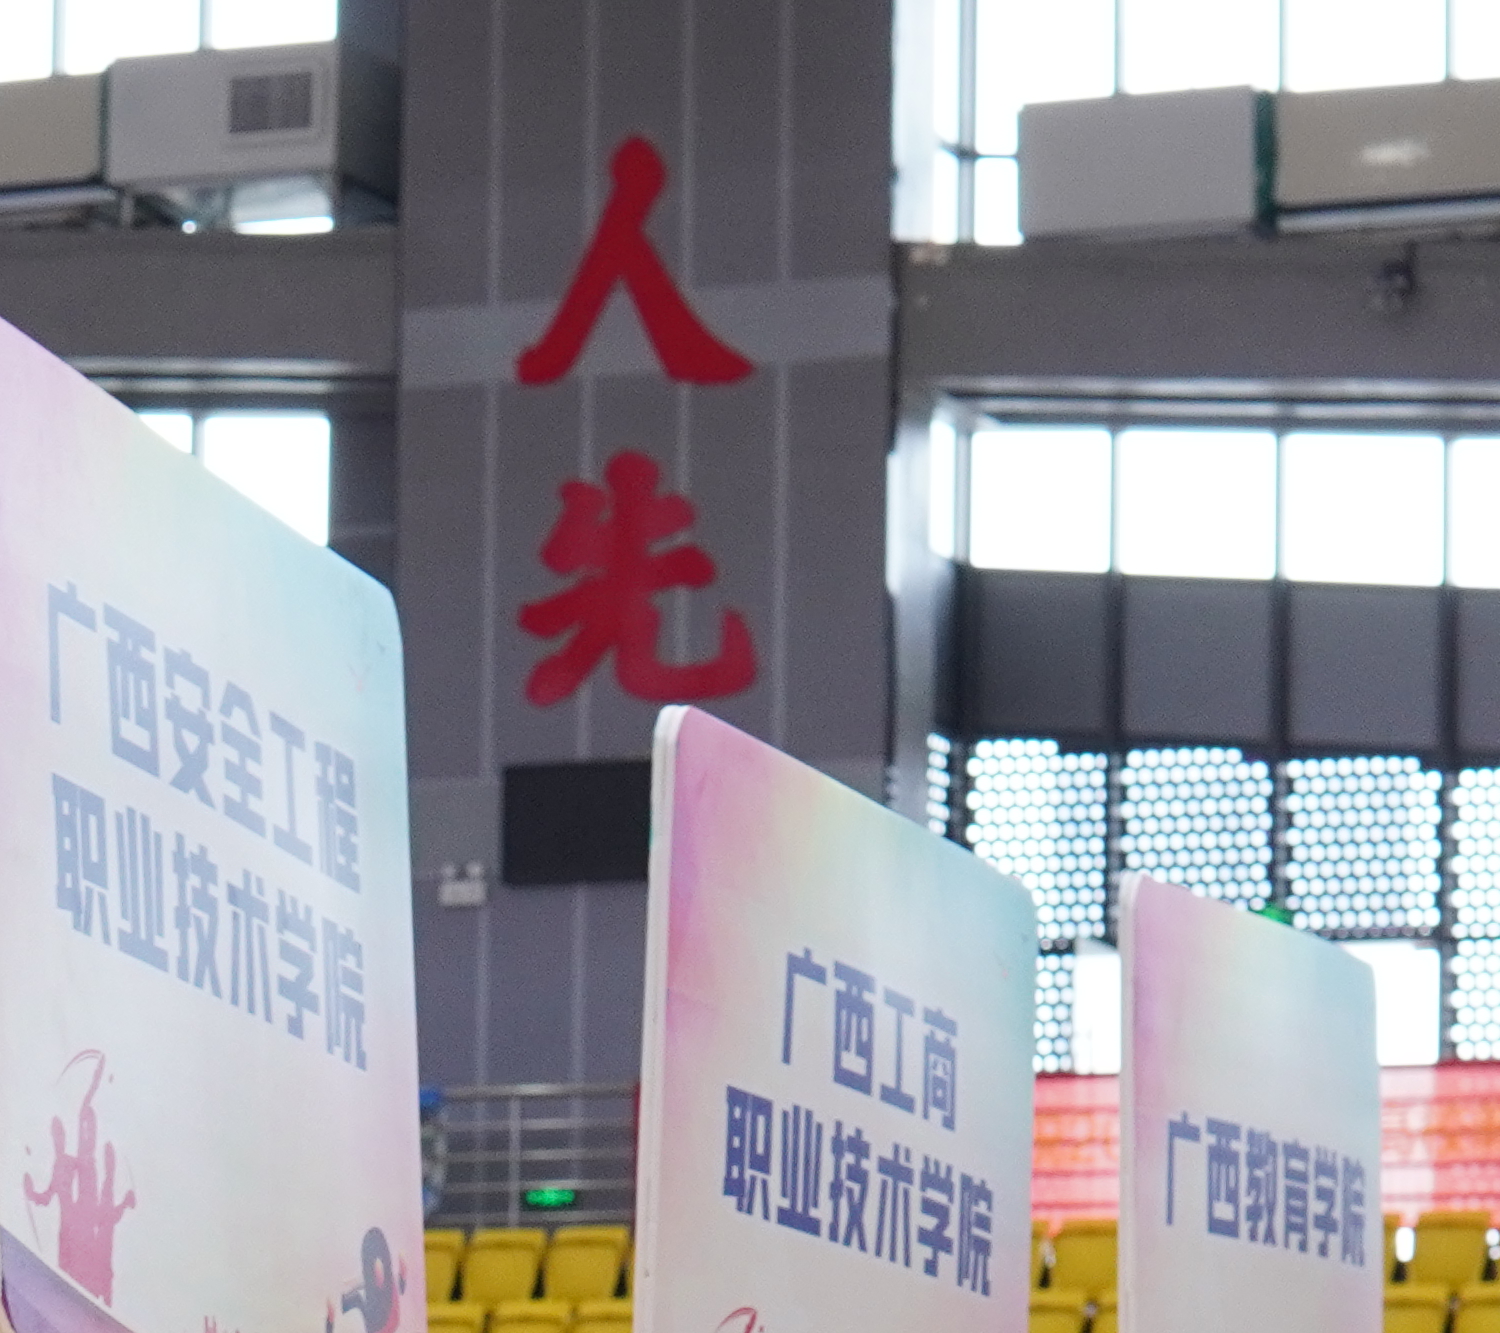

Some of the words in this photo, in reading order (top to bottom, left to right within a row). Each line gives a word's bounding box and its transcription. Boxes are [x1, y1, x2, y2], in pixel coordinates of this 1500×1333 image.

[515, 134, 758, 708] 人先
[46, 580, 362, 895] 广西安全工程
[51, 772, 368, 1072] 职业技术学院
[780, 946, 960, 1132] 广西工商
[722, 1084, 995, 1297] 职业技术学院
[1165, 1109, 1367, 1268] 广西教育学院
